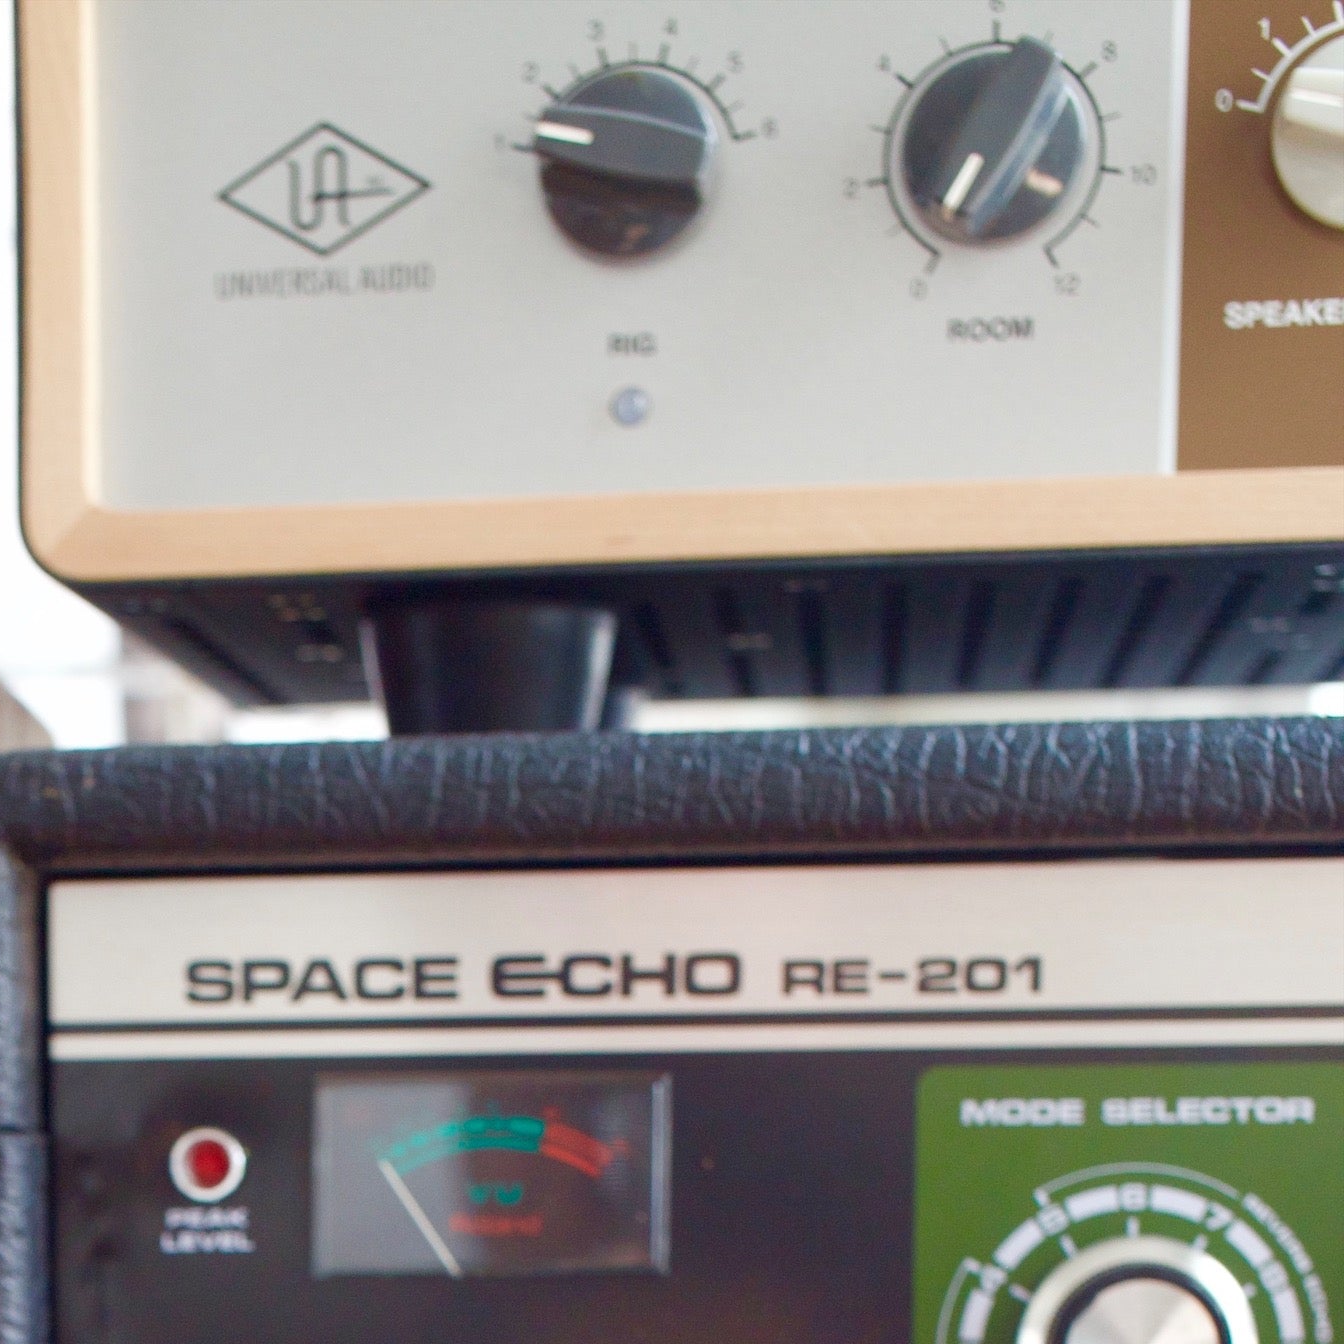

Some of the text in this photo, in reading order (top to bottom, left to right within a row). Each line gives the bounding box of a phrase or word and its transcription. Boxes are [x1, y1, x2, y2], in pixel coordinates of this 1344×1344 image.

[214, 263, 434, 298] UNIVERSAL AUDIO
[947, 317, 1034, 342] ROOM
[184, 953, 1044, 1001] SPACE ECHO RE-201
[960, 1095, 1316, 1127] MODE SELECTOR
[167, 1208, 248, 1230] PEAK
[161, 1232, 254, 1254] LEVEL
